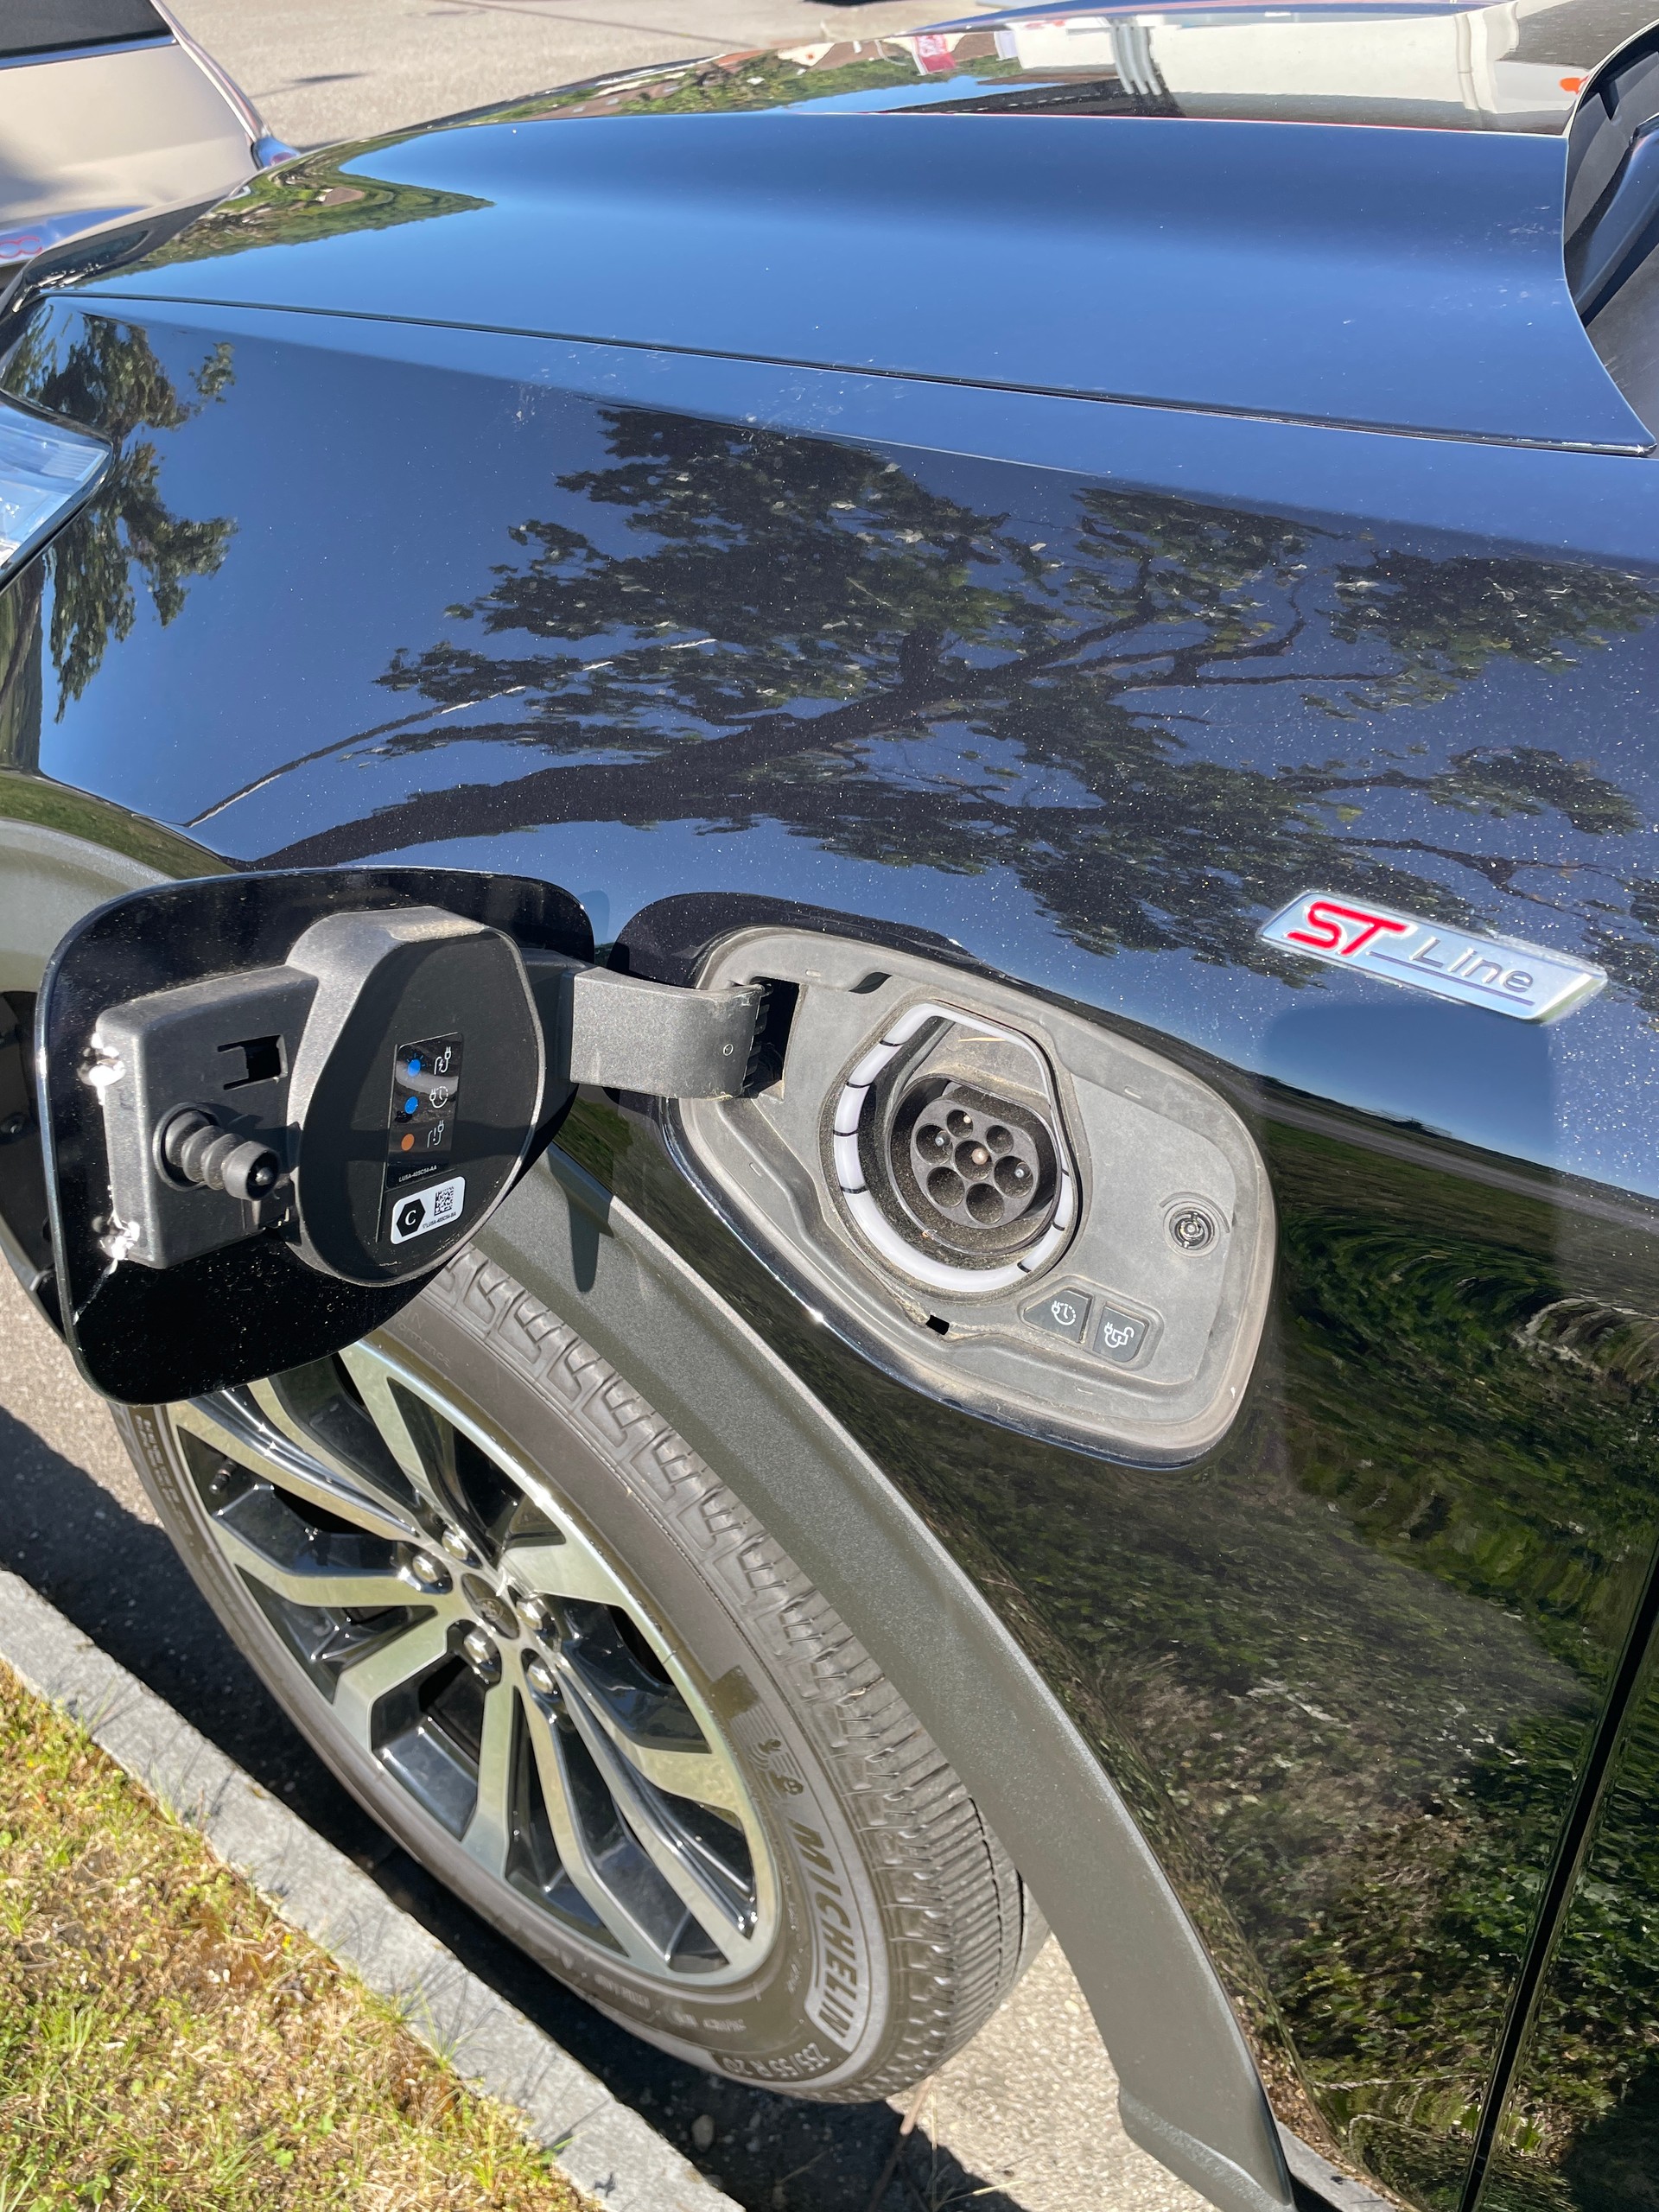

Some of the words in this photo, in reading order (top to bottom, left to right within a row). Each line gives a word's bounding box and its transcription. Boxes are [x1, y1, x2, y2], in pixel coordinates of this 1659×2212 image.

[1285, 899, 1410, 957] ST
[1409, 936, 1535, 994] Line
[404, 1210, 416, 1226] C
[787, 1816, 858, 2039] MICHELIN
